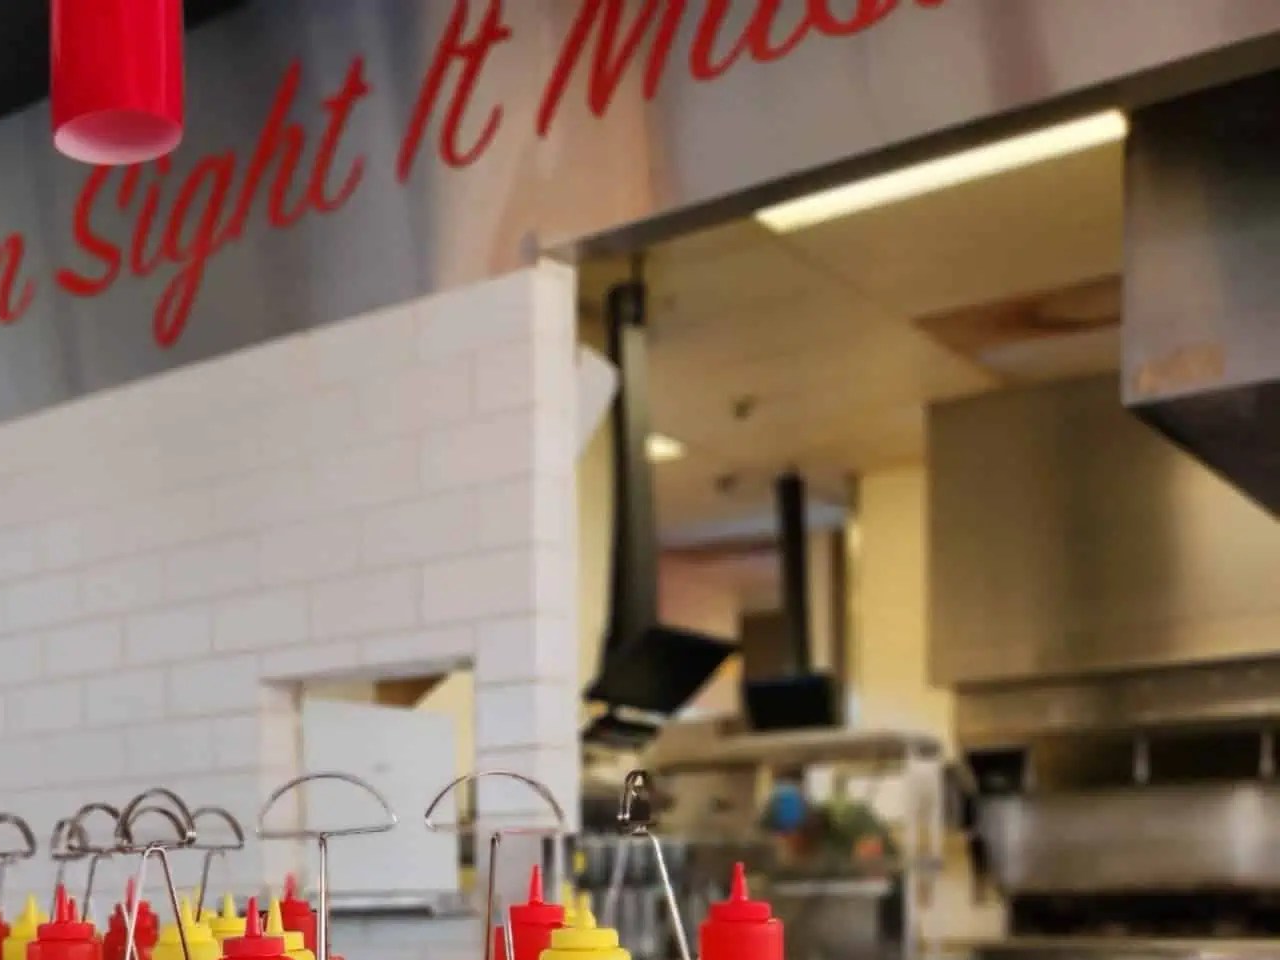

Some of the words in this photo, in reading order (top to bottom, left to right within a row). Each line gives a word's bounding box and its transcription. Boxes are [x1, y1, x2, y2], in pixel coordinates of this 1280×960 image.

[55, 55, 373, 349] Sight
[396, 0, 511, 184] It
[535, 0, 946, 138] Mu
